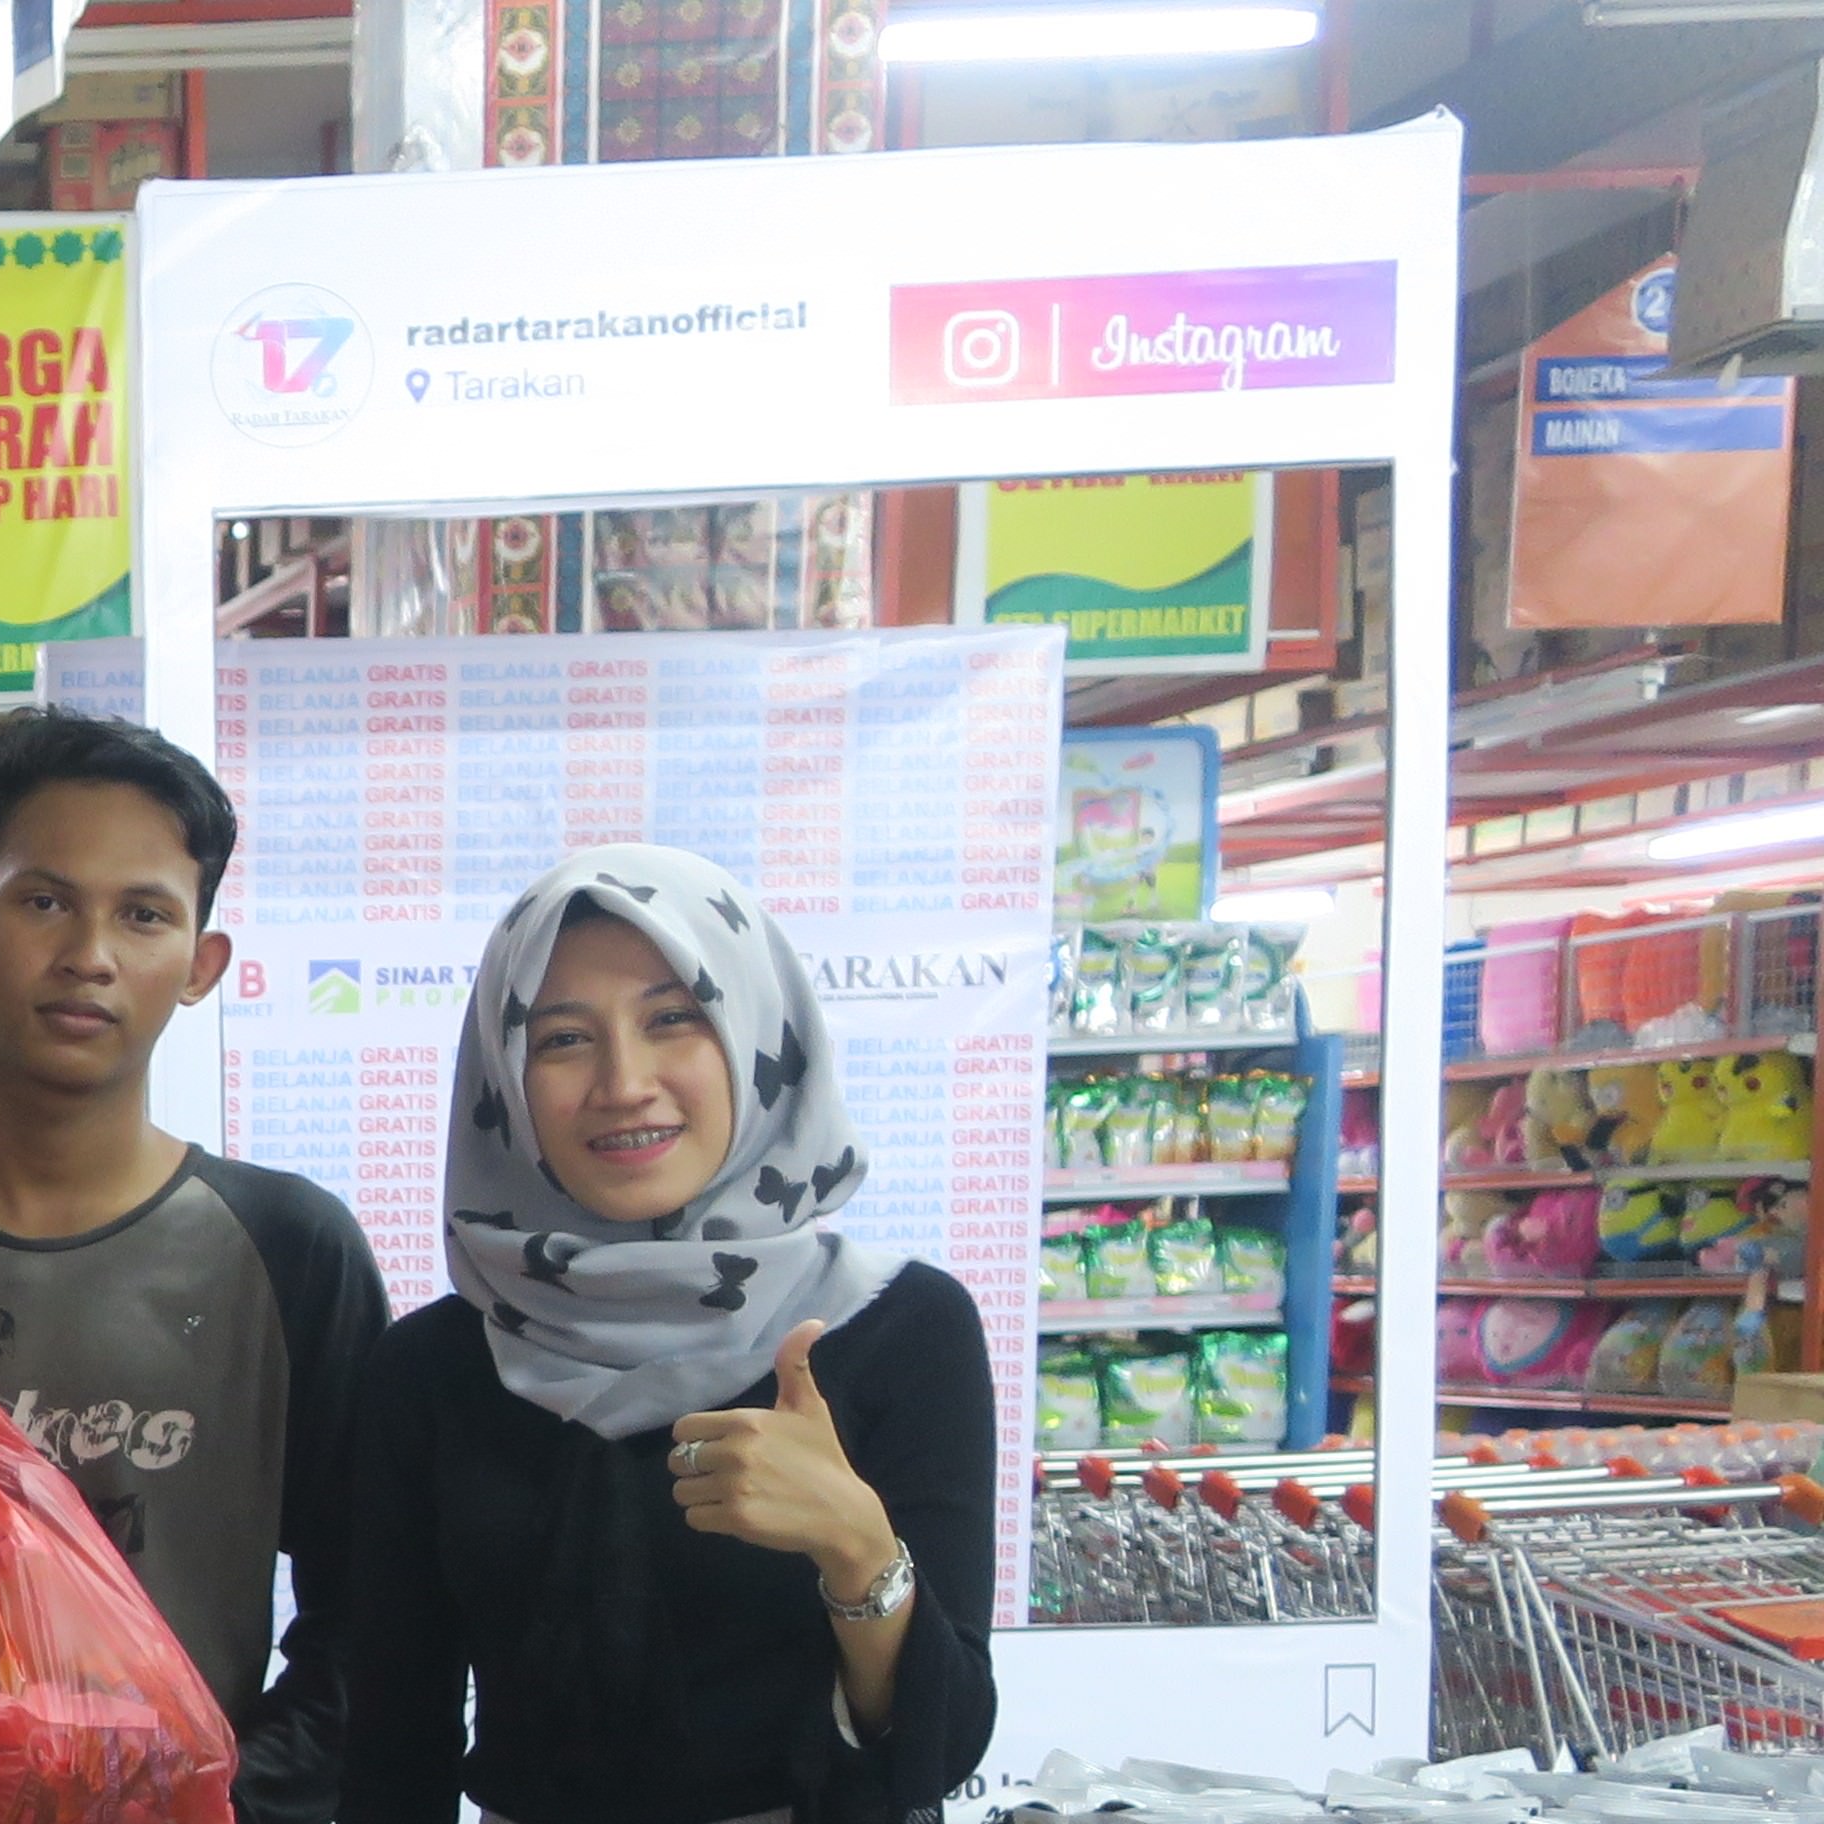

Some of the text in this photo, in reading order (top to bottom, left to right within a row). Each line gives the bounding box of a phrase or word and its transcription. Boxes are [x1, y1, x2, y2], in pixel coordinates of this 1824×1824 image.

[407, 302, 807, 346] radartarakanofficial
[1091, 312, 1340, 391] Instagram
[444, 369, 584, 401] Tarakan
[1549, 365, 1626, 393] BONEKA
[1546, 419, 1620, 447] MAINAN
[23, 474, 118, 521] HARI
[367, 664, 447, 683] GRATIS
[568, 660, 647, 679] GRATIS
[366, 690, 446, 708] GRATIS
[568, 686, 646, 704] GRATIS
[366, 714, 446, 733] GRATIS
[567, 710, 646, 729] GRATIS
[364, 785, 444, 804] GRATIS
[362, 903, 442, 922] GRATIS
[376, 965, 454, 985] SINAR
[956, 1034, 1033, 1052] GRATIS
[360, 1046, 438, 1065] GRATIS
